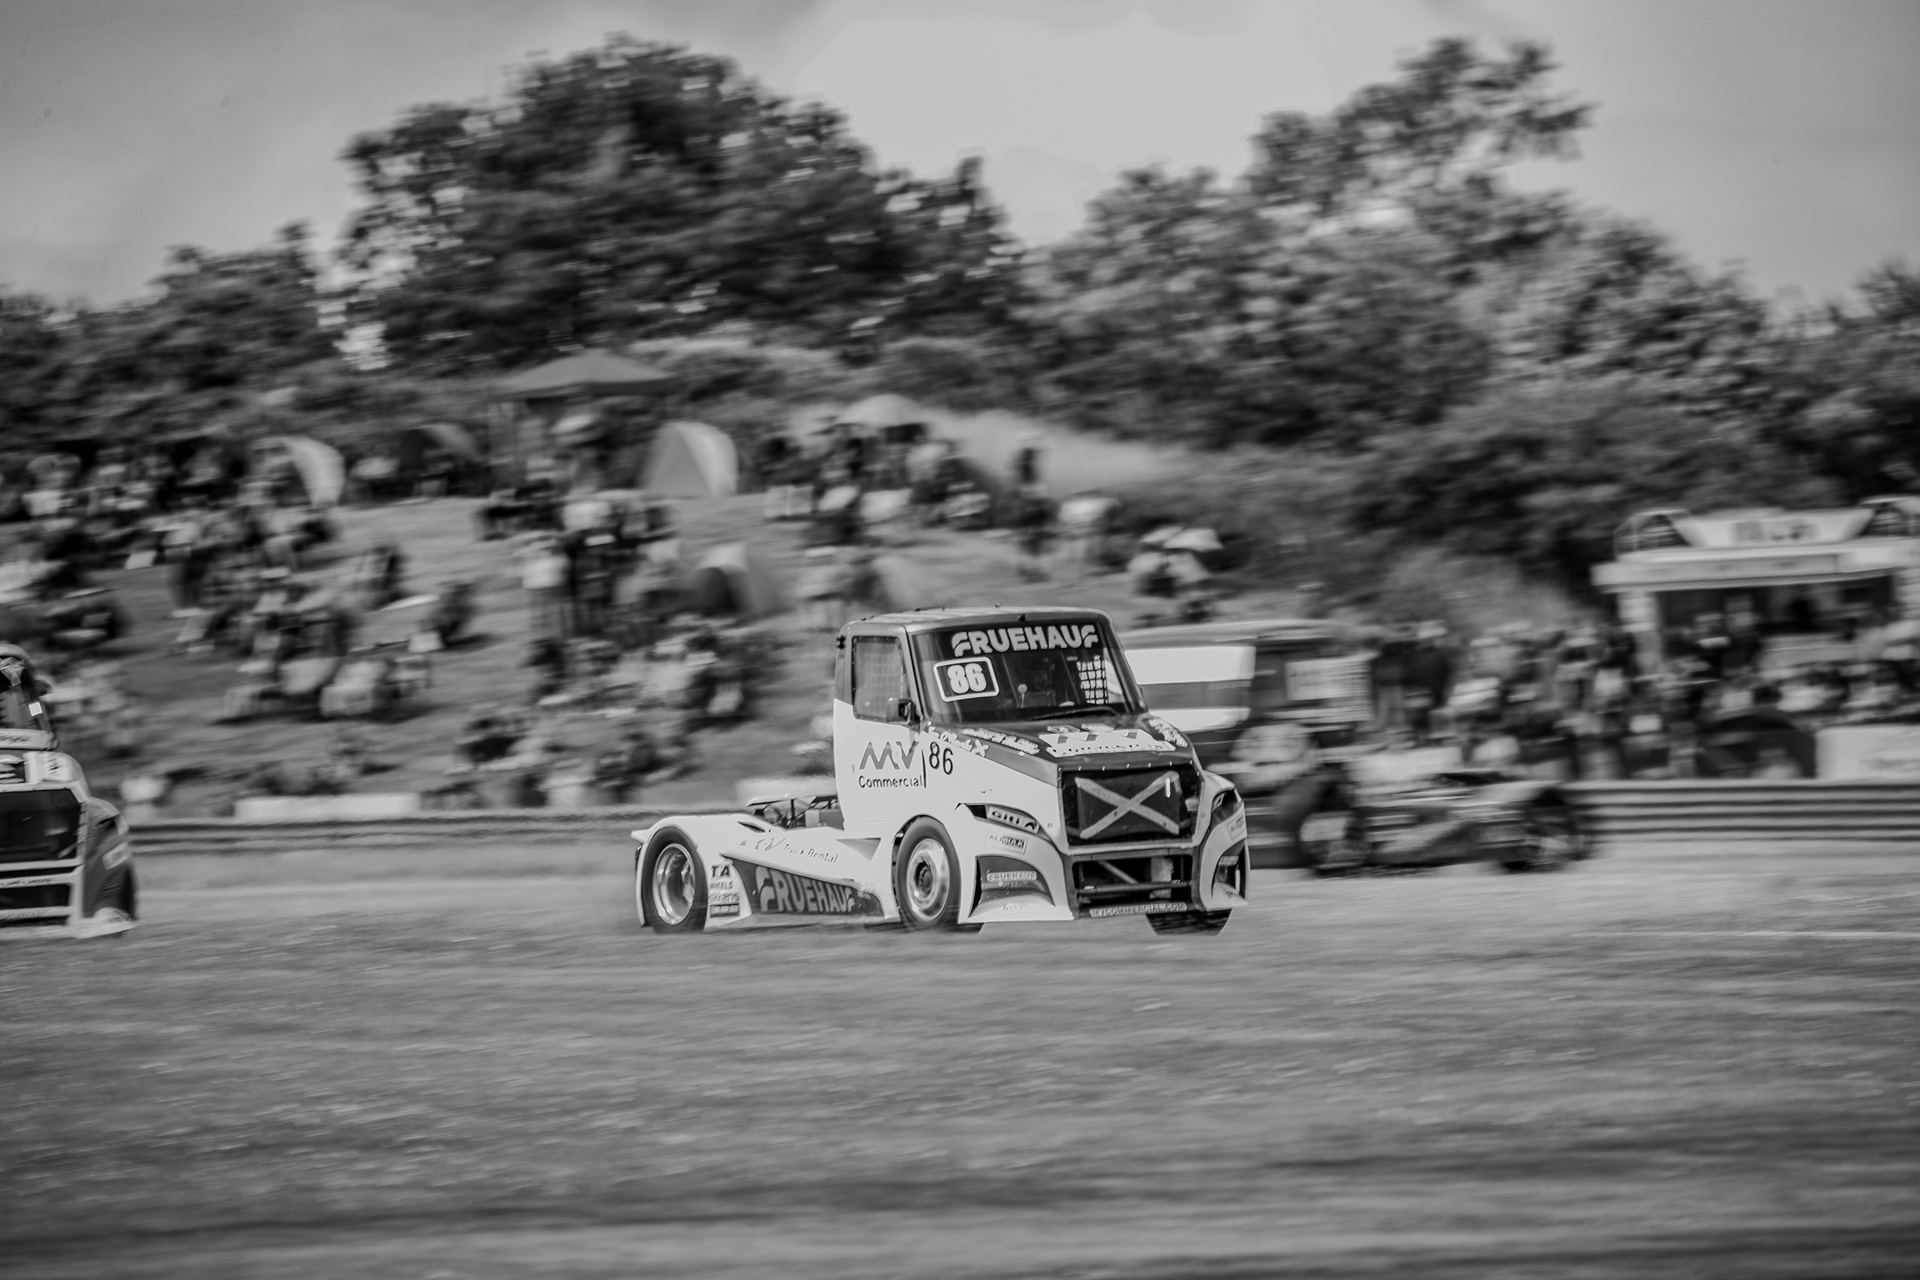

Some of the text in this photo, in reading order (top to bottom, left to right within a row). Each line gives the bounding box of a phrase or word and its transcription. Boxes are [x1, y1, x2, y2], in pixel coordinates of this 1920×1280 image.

[952, 624, 1099, 657] FRUEHAUF
[947, 663, 988, 694] 86
[859, 741, 920, 770] MV
[928, 741, 954, 775] 86
[859, 775, 923, 788] Commercial
[755, 865, 856, 913] FRUEHAUF
